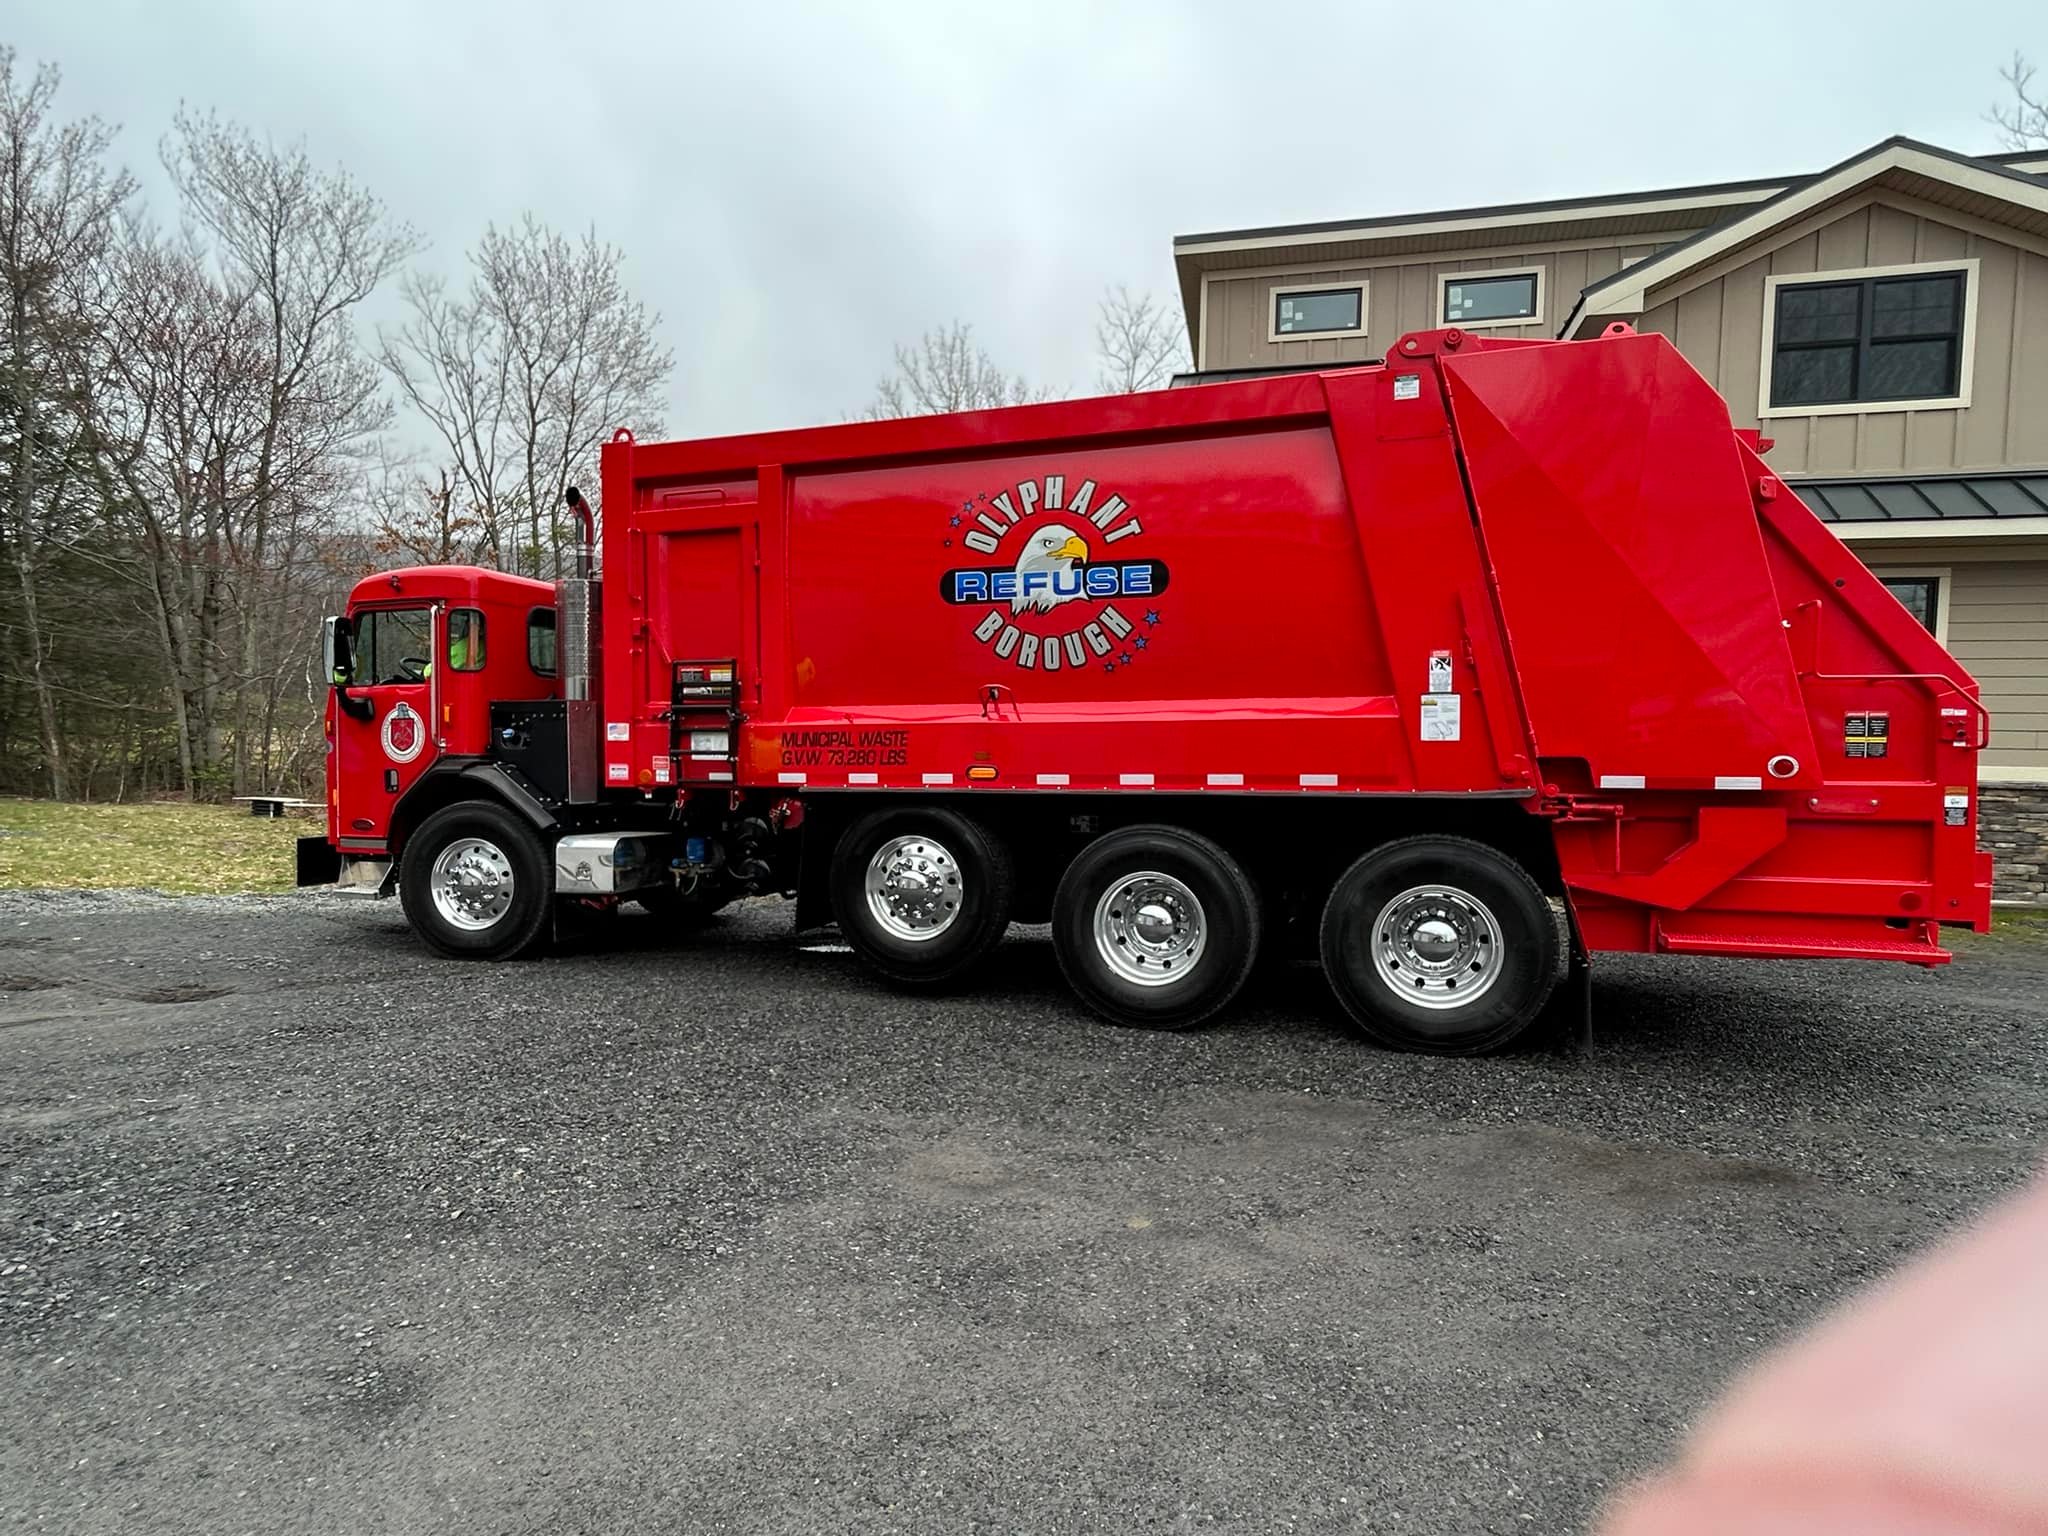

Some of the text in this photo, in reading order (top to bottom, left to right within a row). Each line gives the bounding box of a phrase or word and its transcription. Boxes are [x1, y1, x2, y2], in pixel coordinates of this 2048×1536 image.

[963, 475, 1144, 555] OLYPHANT
[954, 564, 1153, 602] REFUSE
[972, 605, 1135, 671] BOROUGH
[781, 730, 910, 748] MUNICIPAL WASTE
